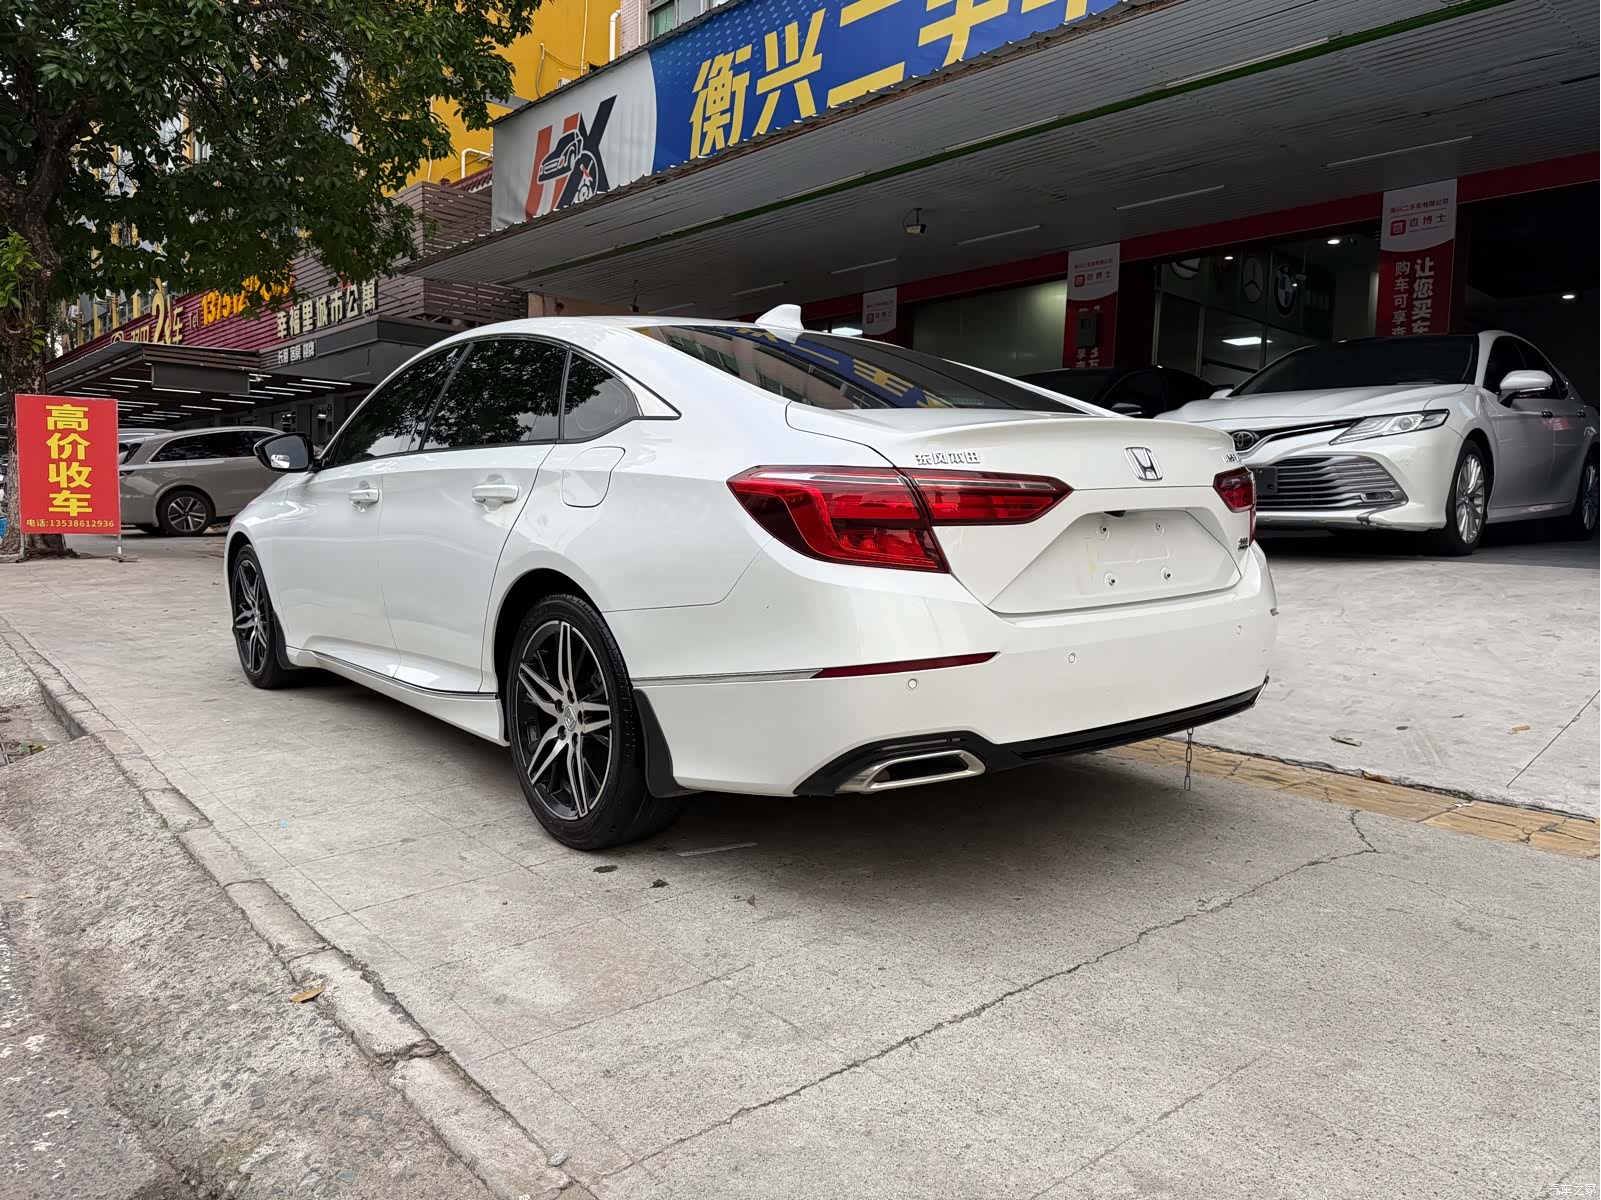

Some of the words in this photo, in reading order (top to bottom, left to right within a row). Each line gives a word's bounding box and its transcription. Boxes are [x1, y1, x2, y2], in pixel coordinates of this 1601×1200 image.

[277, 278, 376, 339] 幸福里城市公寓
[45, 403, 93, 517] 高价收车
[914, 450, 981, 466] 东风本田
[26, 518, 115, 528] 电话:13538612936
